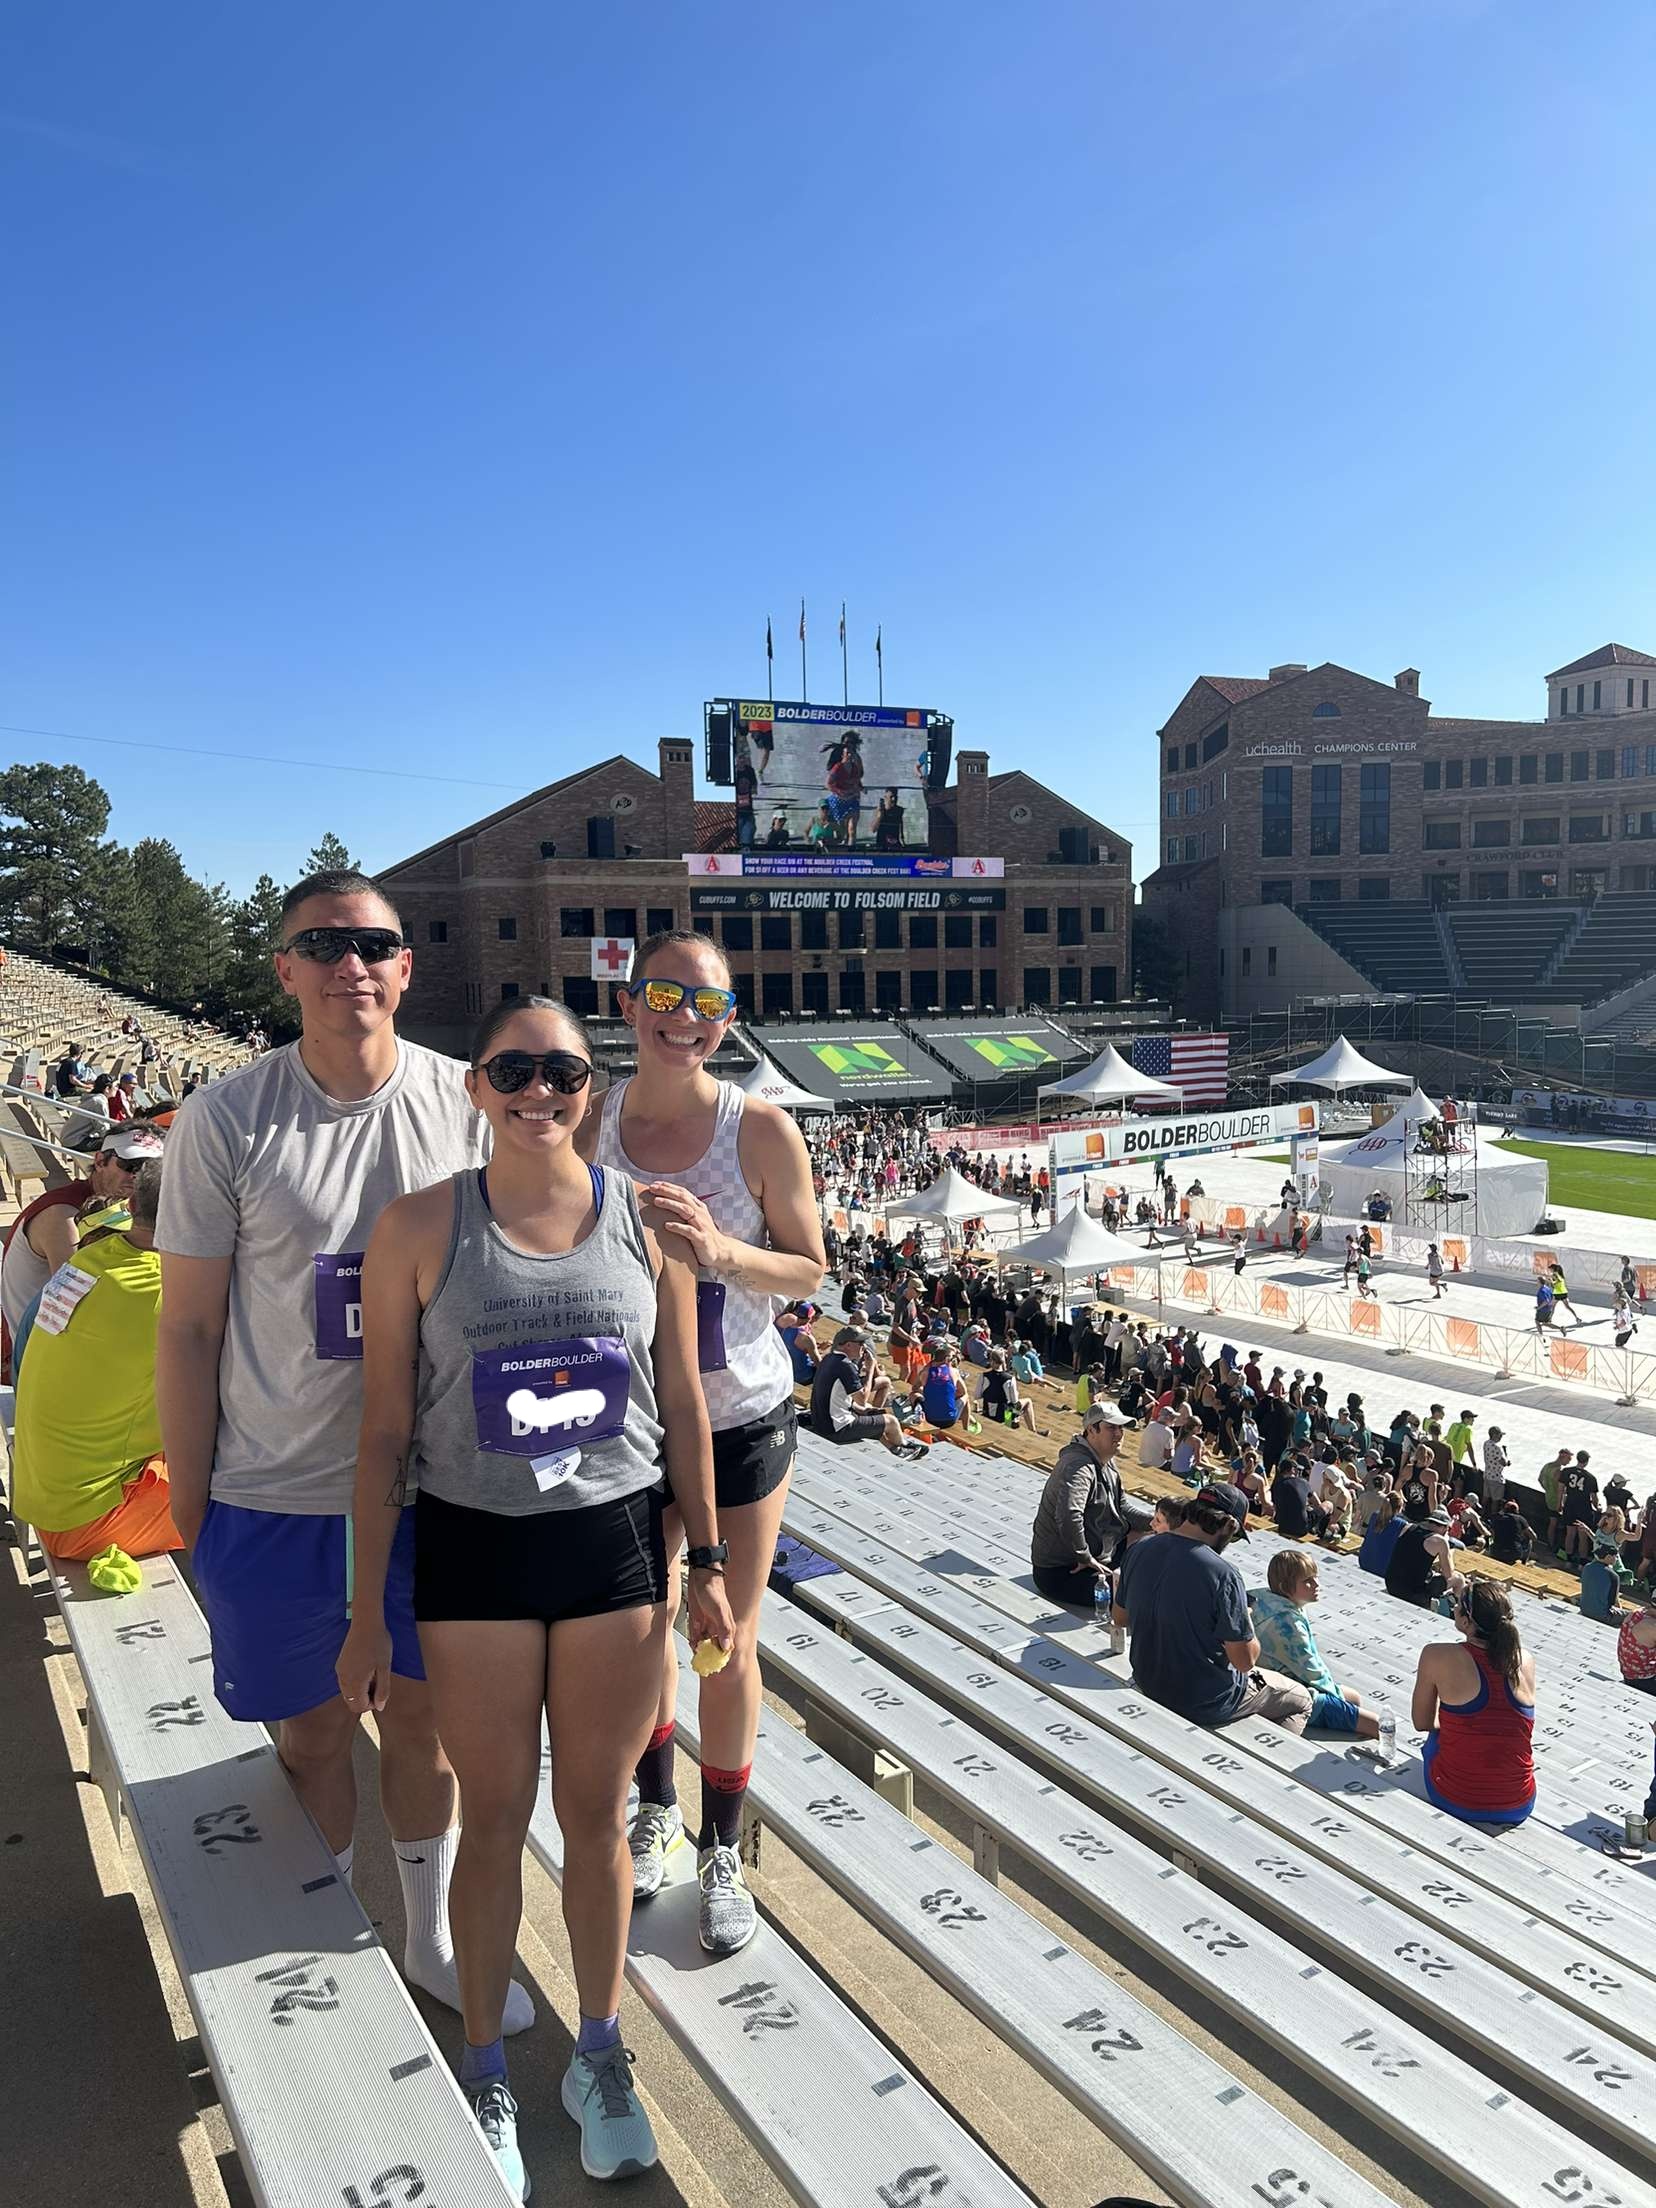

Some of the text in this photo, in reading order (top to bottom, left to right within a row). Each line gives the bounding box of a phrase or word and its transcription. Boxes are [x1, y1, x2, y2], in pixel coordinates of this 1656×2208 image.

[742, 705, 772, 718] 2023
[777, 707, 877, 723] BOLDERBOULDER
[1245, 741, 1302, 756] uchealth
[1314, 742, 1417, 753] CHAMPIONS CENTER
[769, 891, 941, 909] WELCOME TO FOLSOM FIELD
[1123, 1114, 1271, 1153] BOLDERBOULDER
[483, 1288, 624, 1313] University of Saint Mary
[345, 1303, 363, 1338] D
[462, 1321, 508, 1339] Outdoor
[512, 1315, 548, 1331] Track
[553, 1313, 562, 1328] &
[566, 1310, 596, 1325] Field
[597, 1310, 640, 1324] Nationals
[501, 1352, 603, 1372] BOLDERBOULDER
[1568, 1473, 1585, 1491] 34
[832, 1500, 853, 1509] 12
[810, 1522, 835, 1534] 14
[873, 1523, 895, 1534] 13
[941, 1532, 961, 1542] 12
[863, 1554, 887, 1566] 15
[987, 1555, 1010, 1567] 13
[916, 1584, 943, 1597] 16
[972, 1577, 998, 1589] 15
[835, 1591, 863, 1603] 17
[888, 1623, 921, 1639] 18
[976, 1622, 1006, 1634] 17
[783, 1632, 820, 1651] 19
[1036, 1656, 1068, 1672] 18
[965, 1671, 1000, 1690] 19
[1383, 1674, 1404, 1685] 15
[859, 1686, 905, 1711] 20
[1367, 1690, 1391, 1702] 16
[1117, 1702, 1151, 1721] 19
[1044, 1722, 1090, 1746] 20
[1253, 1731, 1286, 1748] 19
[1541, 1726, 1565, 1739] 16
[1624, 1731, 1645, 1742] 15
[951, 1752, 999, 1777] 21
[1201, 1752, 1244, 1777] 20
[1343, 1780, 1385, 1802] 20
[1608, 1777, 1636, 1791] 18
[1146, 1786, 1188, 1810] 21
[804, 1794, 866, 1828] 22
[191, 1803, 263, 1856] 23
[1310, 1816, 1352, 1838] 21
[1057, 1830, 1113, 1862] 22
[1447, 1836, 1486, 1858] 21
[1254, 1855, 1309, 1884] 22
[1592, 1868, 1628, 1889] 21
[1420, 1879, 1473, 1909] 22
[919, 1888, 989, 1932] 23
[1563, 1898, 1615, 1928] 22
[1181, 1916, 1250, 1957] 23
[1393, 1940, 1457, 1979] 23
[1562, 1961, 1623, 1996] 23
[252, 1953, 342, 2027] 24
[715, 1979, 800, 2042] 24
[1061, 2006, 1145, 2062] 24
[1340, 2027, 1422, 2078] 24
[1561, 2044, 1635, 2090] 24
